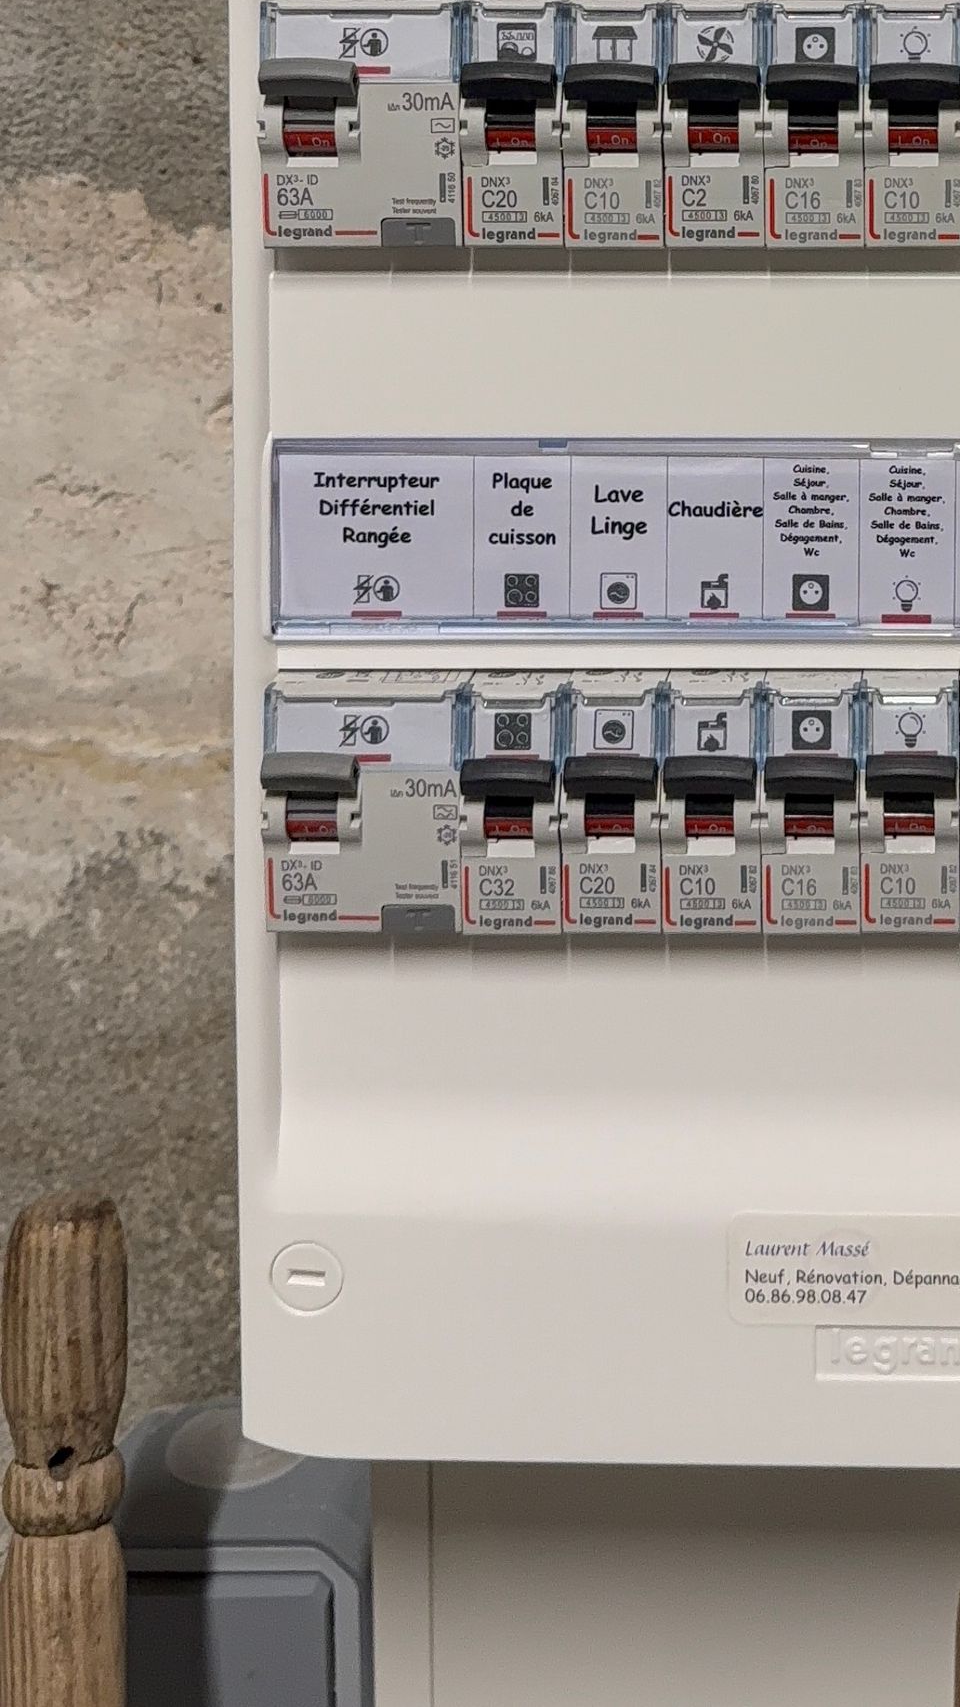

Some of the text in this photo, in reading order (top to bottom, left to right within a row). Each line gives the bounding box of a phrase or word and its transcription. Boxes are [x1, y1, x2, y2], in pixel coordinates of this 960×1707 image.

[403, 93, 454, 111] 30mA
[277, 188, 313, 206] 63A
[482, 190, 517, 208] C20
[585, 192, 619, 209] C10
[682, 189, 706, 206] C2
[786, 192, 820, 209] C16
[884, 192, 919, 209] C10
[534, 212, 554, 222] 6kA
[734, 210, 753, 221] 6kA
[278, 226, 332, 239] legrand
[482, 228, 535, 242] legrand
[584, 230, 637, 242] legrand
[682, 227, 735, 242] legrand
[785, 230, 838, 243] legrand
[884, 230, 936, 243] legrand
[314, 473, 439, 491] Interrupteur
[492, 474, 552, 493] Plaque
[594, 486, 644, 504] Lave
[773, 492, 796, 502] Salle
[869, 494, 893, 502] Salle
[319, 500, 435, 517] Différentiel
[511, 501, 534, 518] de
[668, 501, 764, 518] Chaudière
[788, 506, 834, 516] Chambre,
[591, 518, 647, 539] Linge
[775, 520, 799, 528] Salle
[803, 520, 816, 528] de
[870, 521, 895, 530] Salle
[900, 521, 911, 530] de
[343, 528, 411, 547] Rangée
[489, 531, 556, 546] cuisson
[804, 548, 820, 557] Wc
[900, 549, 915, 558] Wc
[406, 779, 457, 798] 30mA
[282, 873, 317, 891] 63A
[480, 879, 514, 896] C32
[580, 877, 615, 894] C20
[680, 878, 716, 895] C10
[782, 878, 816, 895] C16
[881, 877, 916, 894] C10
[531, 900, 550, 910] 6kA
[631, 898, 650, 908] 6kA
[732, 899, 751, 910] 6kA
[284, 910, 337, 922] legrand
[480, 915, 532, 929] legrand
[580, 914, 632, 928] legrand
[680, 915, 733, 928] legrand
[781, 916, 834, 929] legrand
[880, 915, 932, 927] legrand
[745, 1241, 870, 1257] Laurent Massé
[745, 1270, 790, 1286] Neuf,
[796, 1271, 887, 1286] Rénovation,
[745, 1289, 867, 1304] 06.86.98.08.47
